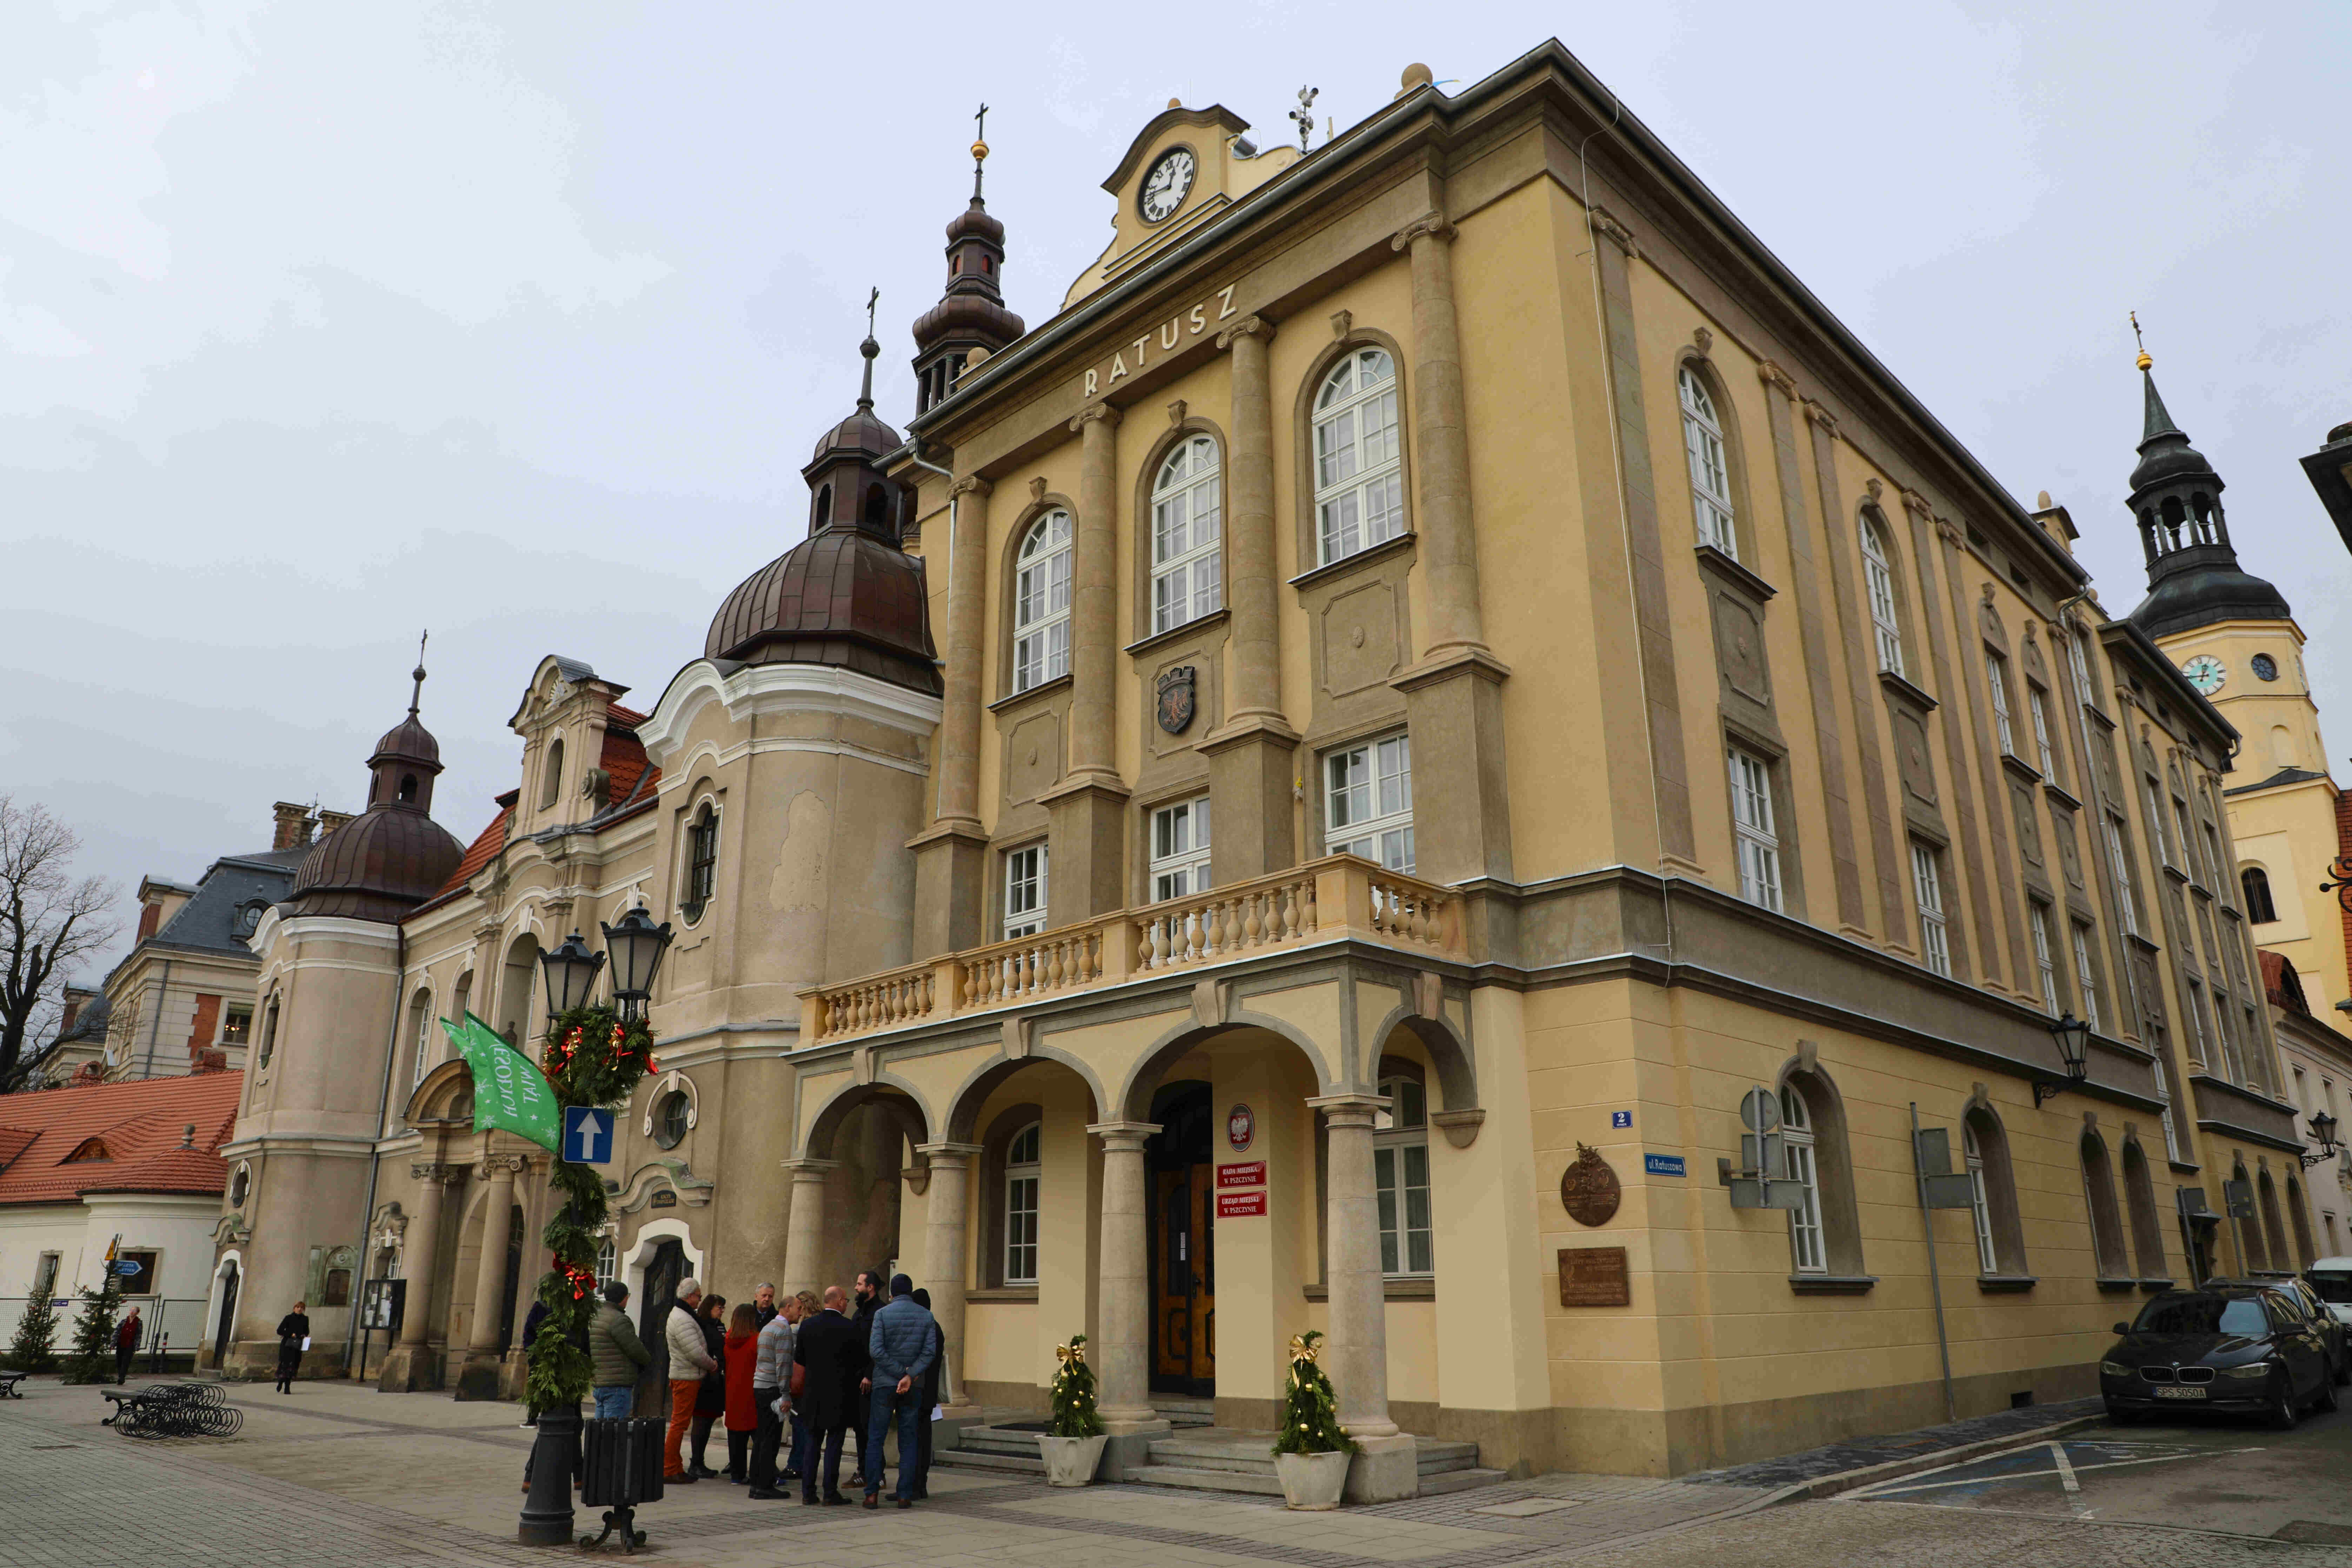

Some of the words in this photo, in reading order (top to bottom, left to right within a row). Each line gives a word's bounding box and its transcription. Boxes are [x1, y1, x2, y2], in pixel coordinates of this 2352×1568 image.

[1084, 284, 1237, 398] RATUSZ
[1618, 1113, 1625, 1123] 2
[2157, 1388, 2174, 1397] SPS
[2177, 1388, 2205, 1398] 5050A
